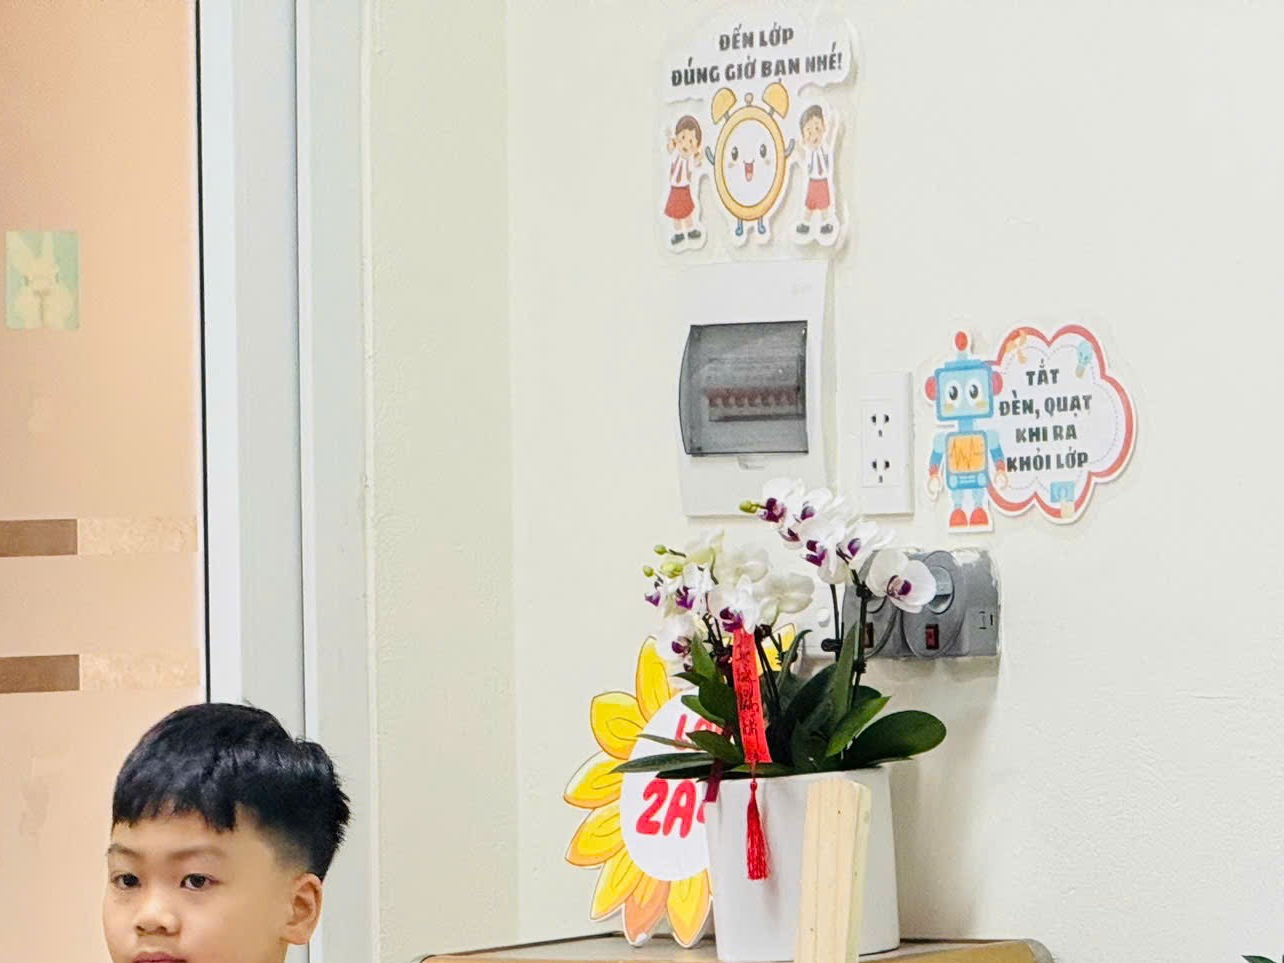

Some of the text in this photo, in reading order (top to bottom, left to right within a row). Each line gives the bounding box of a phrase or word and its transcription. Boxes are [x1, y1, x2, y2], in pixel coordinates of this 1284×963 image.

[719, 22, 794, 51] ĐẾN LỚP
[671, 41, 842, 86] ĐÚNG GIỜ BẠN NHÉ!
[1026, 358, 1059, 386] TẮT
[999, 390, 1092, 419] ĐÈN, QUẠT
[1015, 424, 1077, 443] KHI RA
[1006, 446, 1089, 472] KHỎI LỚP
